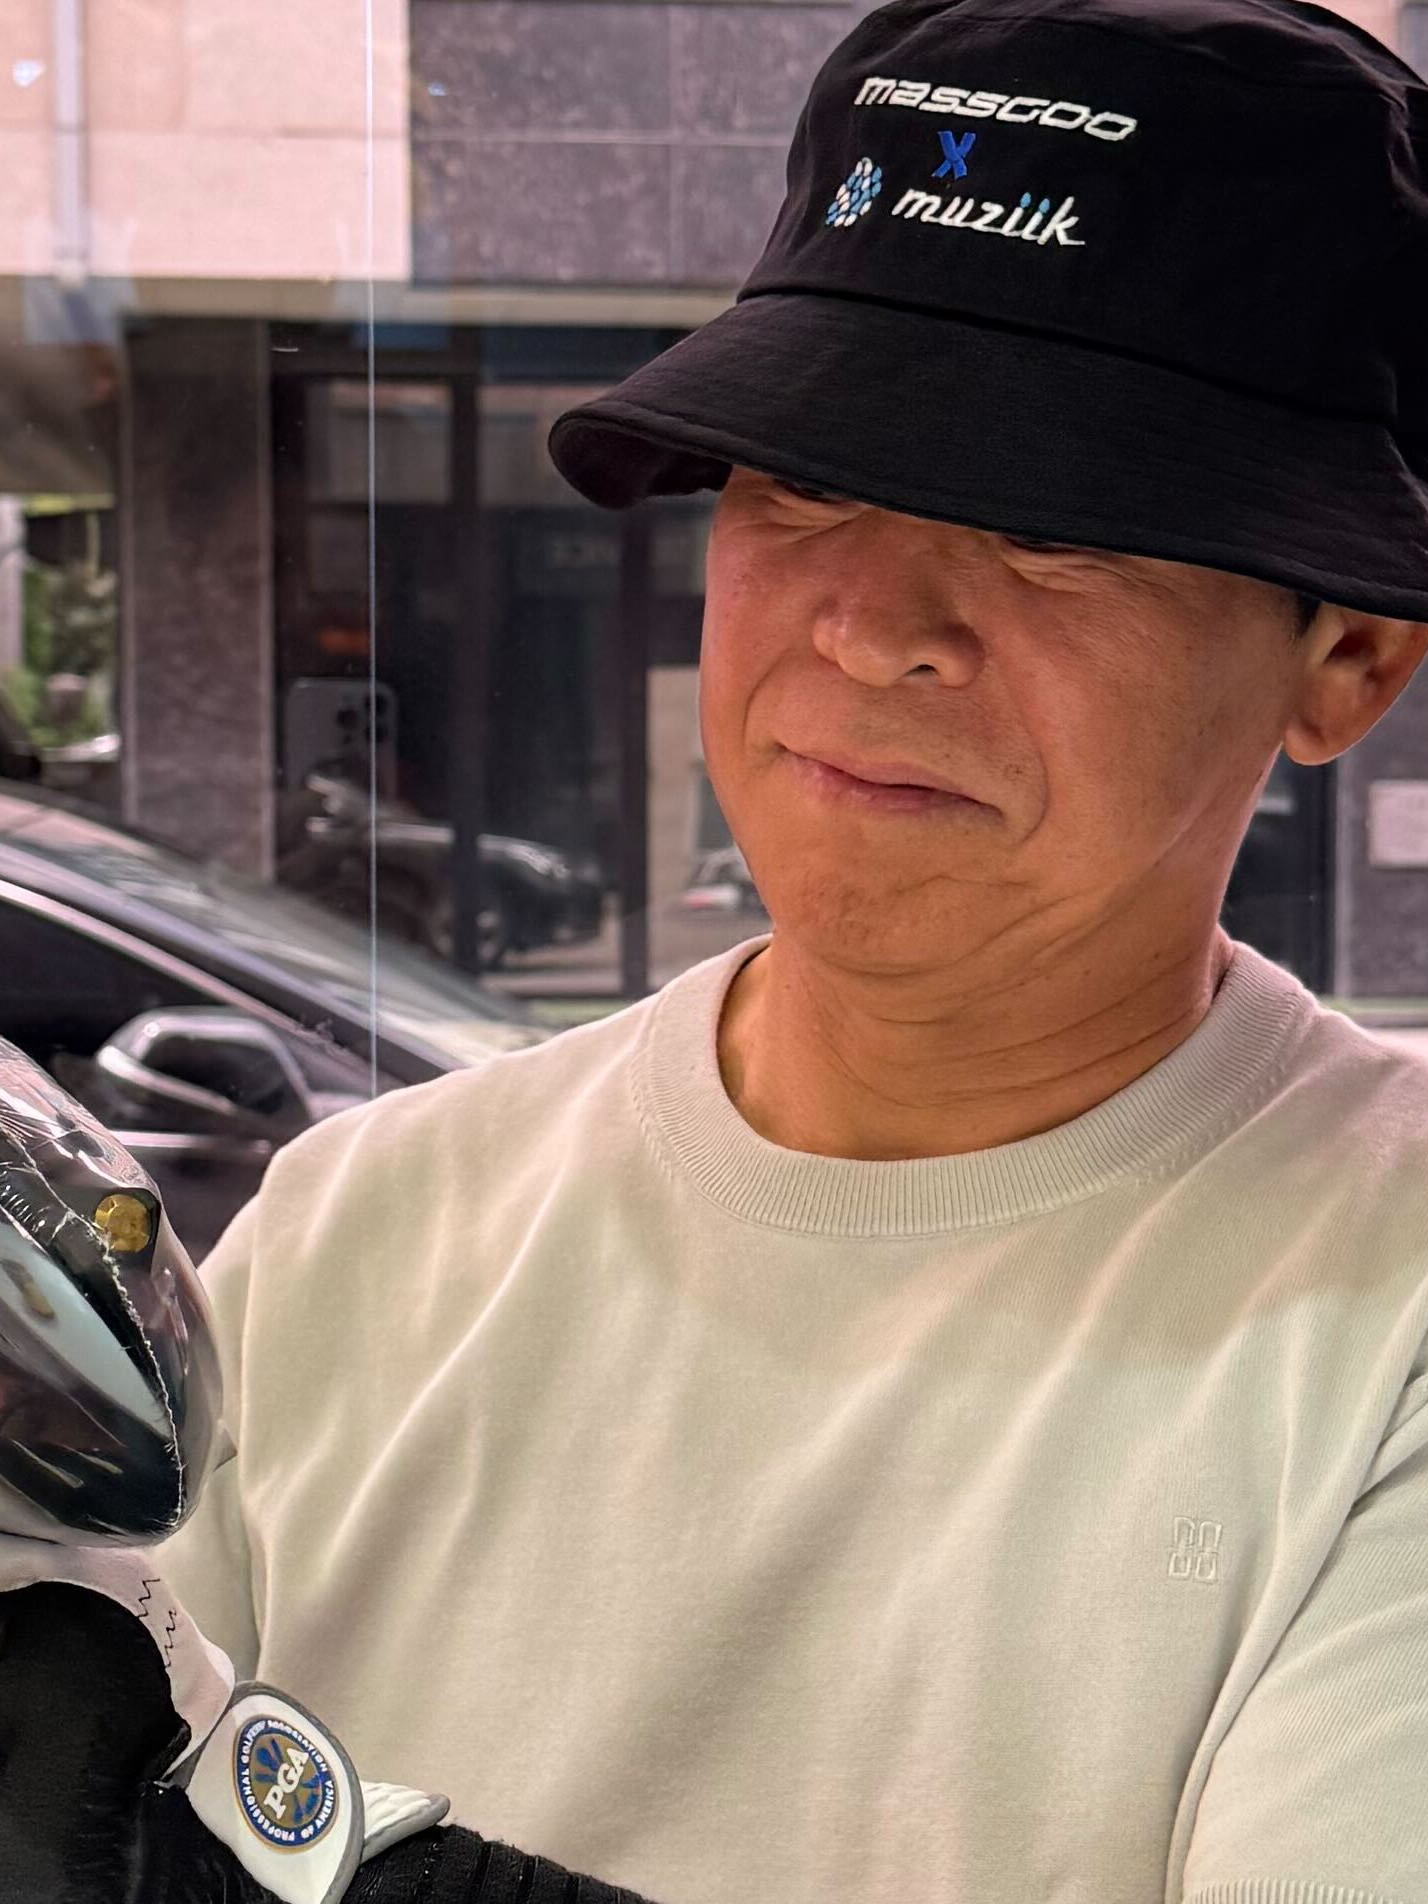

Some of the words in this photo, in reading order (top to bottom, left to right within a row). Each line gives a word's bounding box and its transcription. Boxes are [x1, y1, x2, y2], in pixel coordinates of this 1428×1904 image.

[931, 130, 976, 180] X
[891, 188, 1086, 245] muziik
[263, 1748, 309, 1819] PGA
